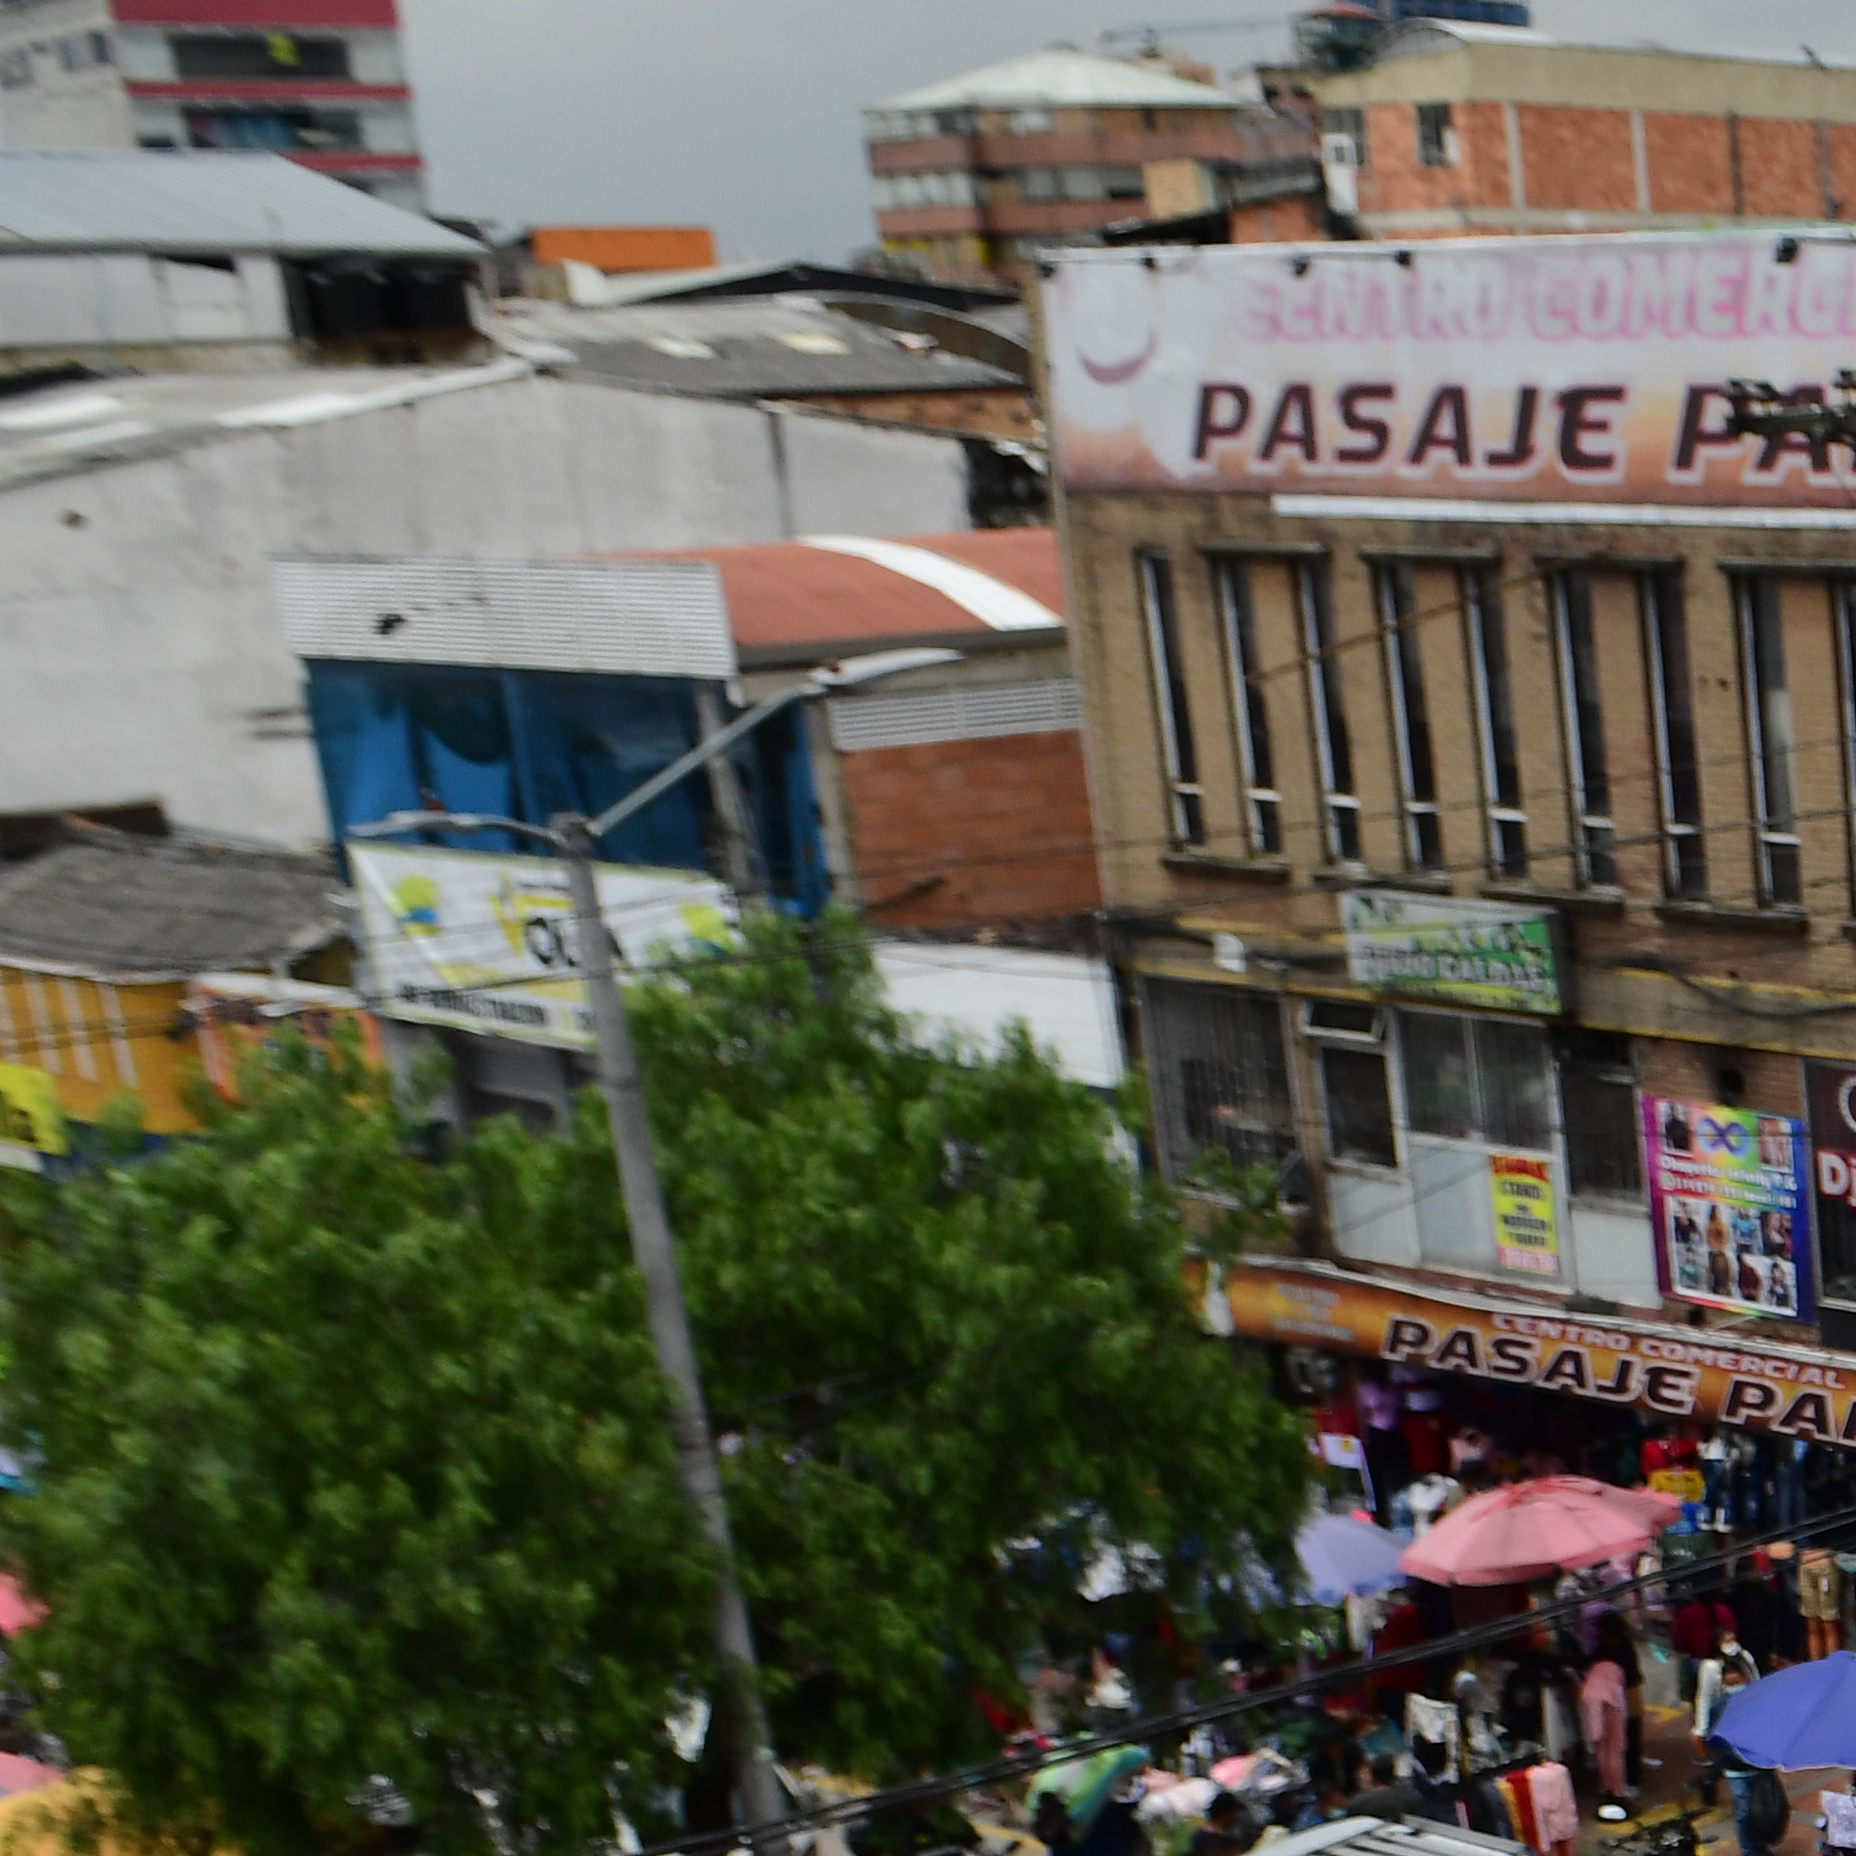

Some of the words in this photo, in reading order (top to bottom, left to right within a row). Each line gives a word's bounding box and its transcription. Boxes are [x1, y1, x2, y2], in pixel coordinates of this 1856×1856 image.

[1233, 254, 1512, 345] CENTRO
[1190, 381, 1628, 473] PASAJE
[1382, 1317, 1699, 1415] PASAJE
[1492, 1311, 1629, 1356] CENTRO
[1637, 1334, 1847, 1391] COMERCIAL
